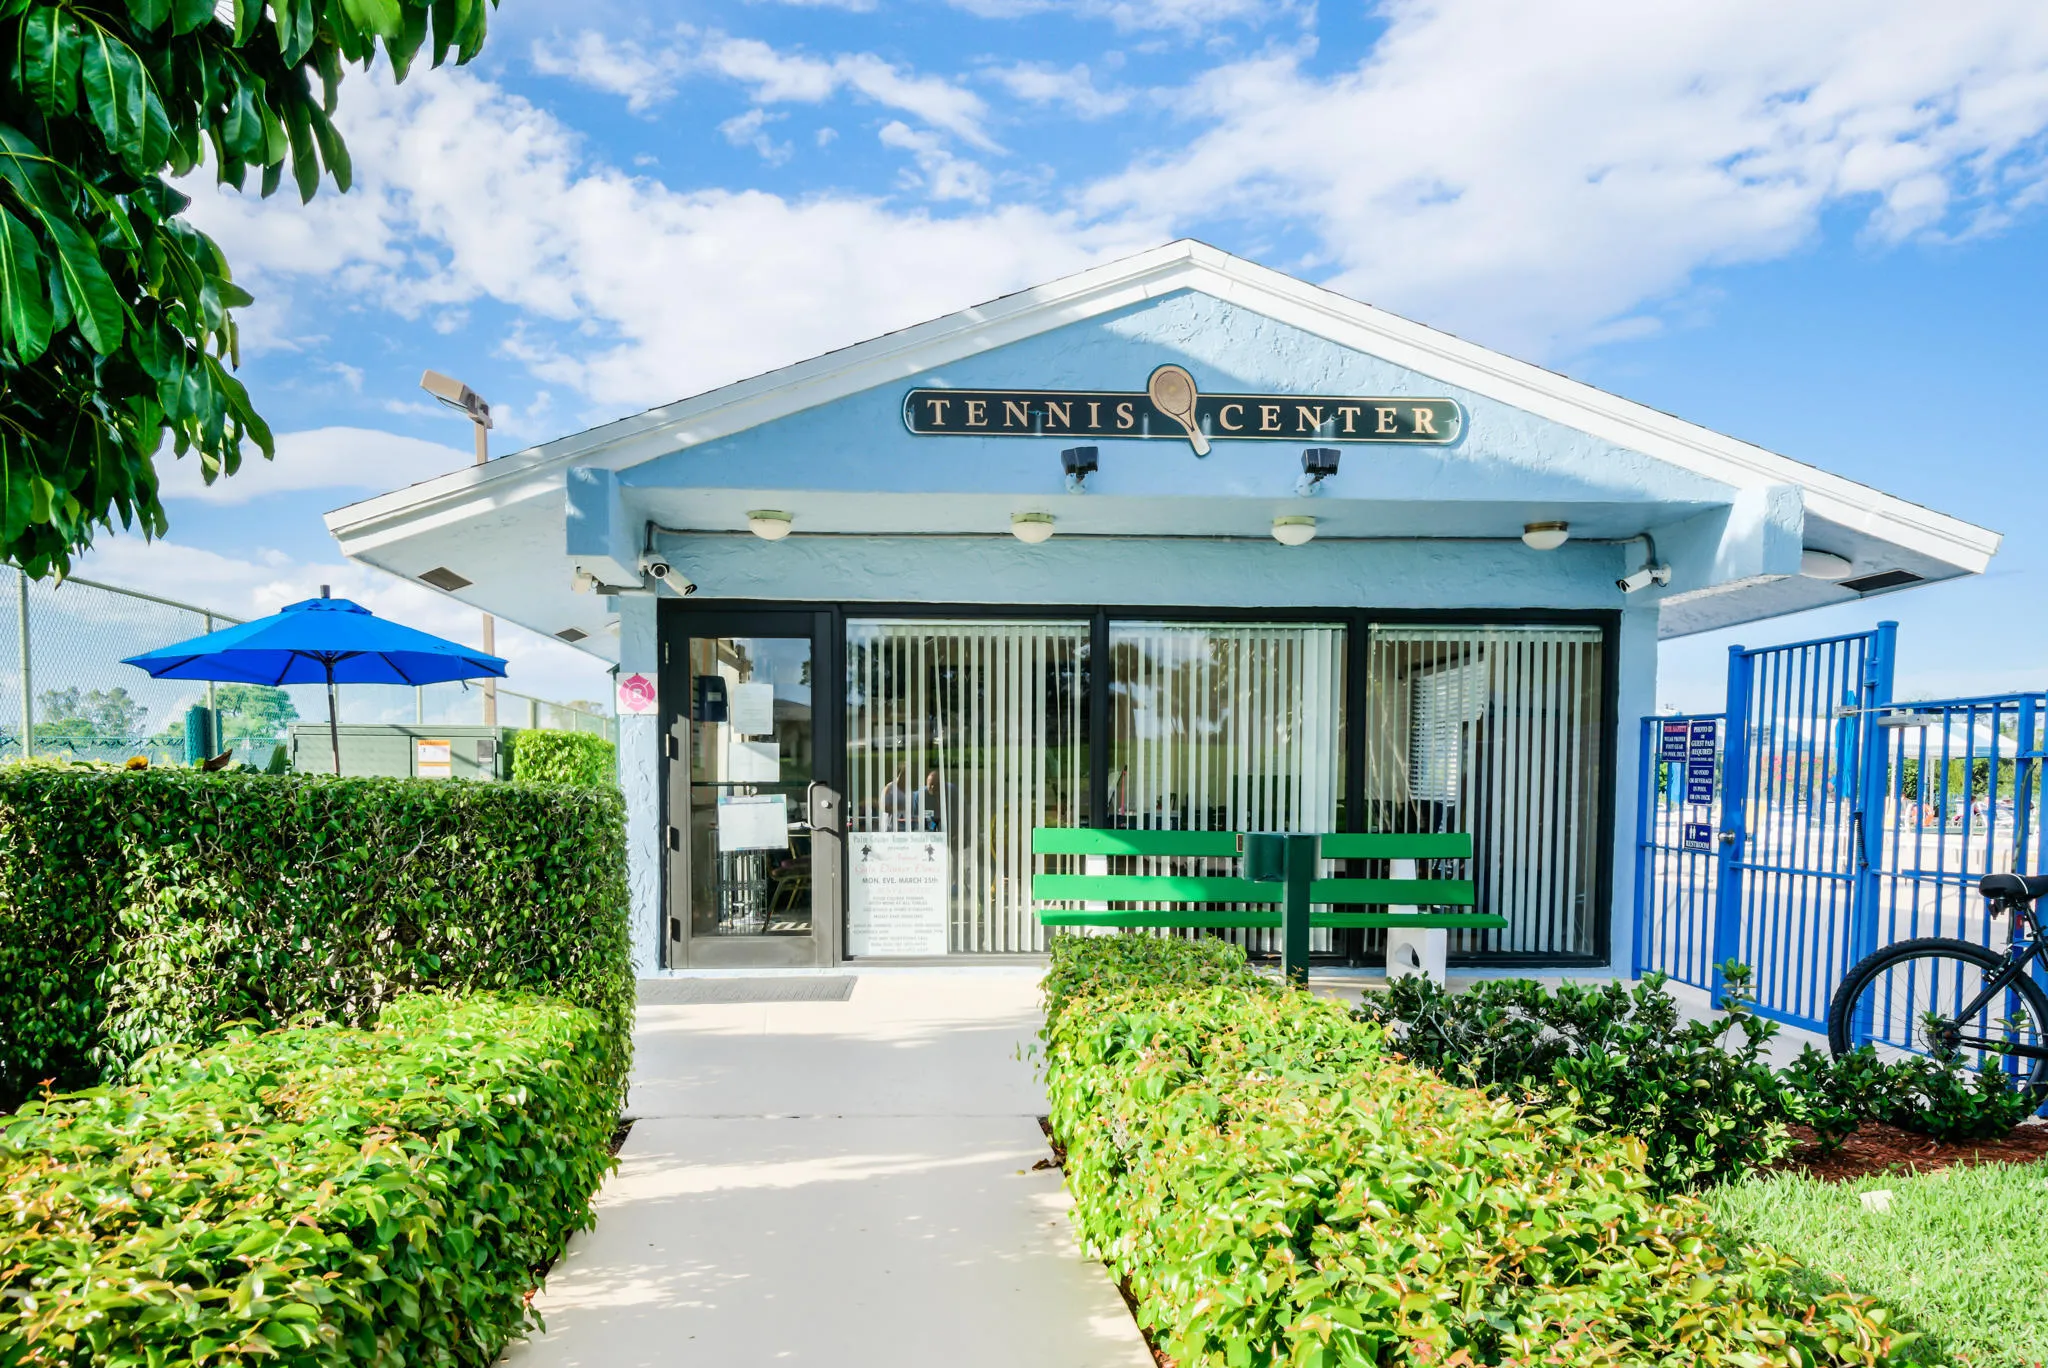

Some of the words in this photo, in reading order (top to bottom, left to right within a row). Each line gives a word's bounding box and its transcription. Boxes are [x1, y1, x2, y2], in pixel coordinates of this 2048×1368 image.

[927, 399, 1135, 429] TENNIS
[1219, 404, 1438, 434] CENTER
[1686, 841, 1709, 849] RESTROOM
